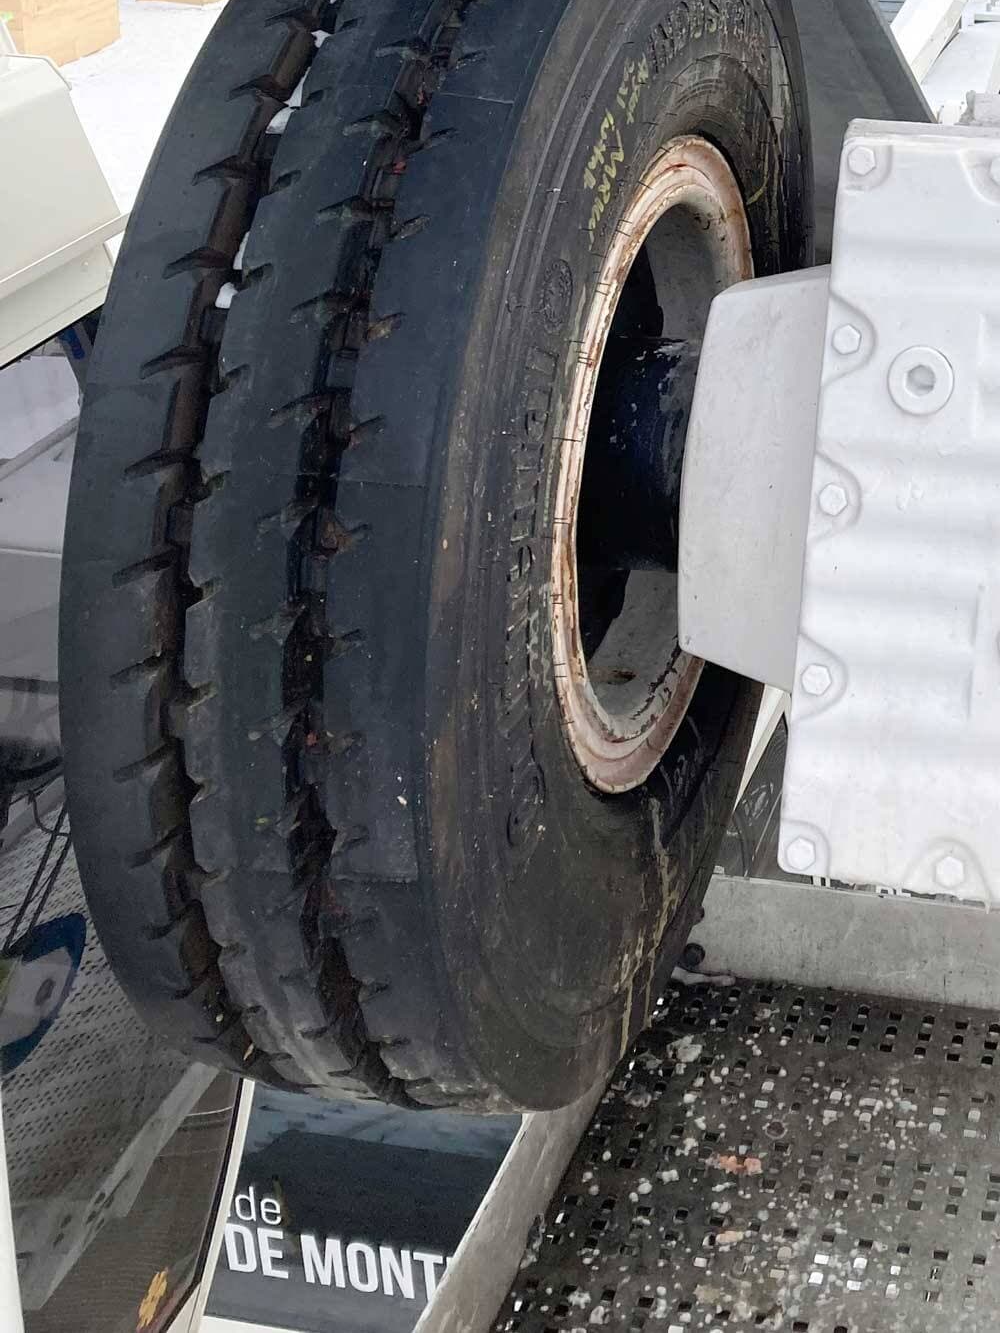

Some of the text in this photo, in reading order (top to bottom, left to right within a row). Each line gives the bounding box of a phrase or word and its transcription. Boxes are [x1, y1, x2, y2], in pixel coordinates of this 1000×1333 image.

[228, 1185, 282, 1226] de
[224, 1222, 454, 1303] DE MONT
